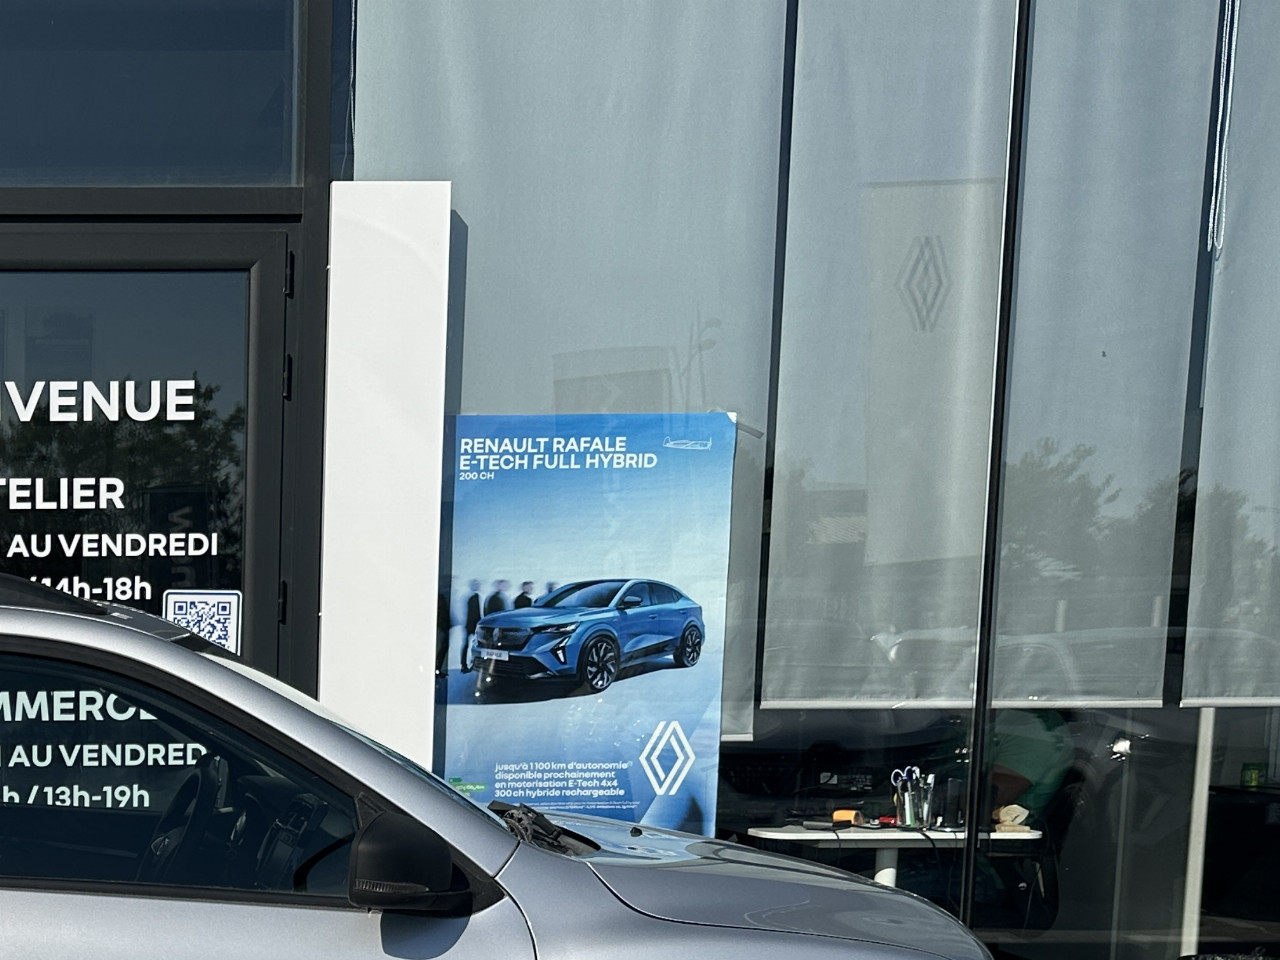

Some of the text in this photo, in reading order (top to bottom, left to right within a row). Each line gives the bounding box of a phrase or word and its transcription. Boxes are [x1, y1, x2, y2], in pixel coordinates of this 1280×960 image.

[460, 436, 627, 454] RENAULT RAFALE
[459, 453, 658, 471] E-TECH FULL HYBRID
[459, 471, 495, 481] 200 CH
[6, 534, 53, 558] AU
[57, 532, 219, 558] VENDREDI
[7, 744, 52, 768] AU
[58, 743, 208, 767] VENDRED
[551, 761, 567, 770] km
[494, 769, 616, 781] disponible prochainement
[494, 781, 507, 789] en
[507, 779, 567, 789] motorisation
[568, 778, 600, 788] E-Tech
[600, 778, 619, 787] 4x4
[43, 784, 150, 808] 13h-19h
[494, 787, 626, 799] 300 ch hybride rechargeable
